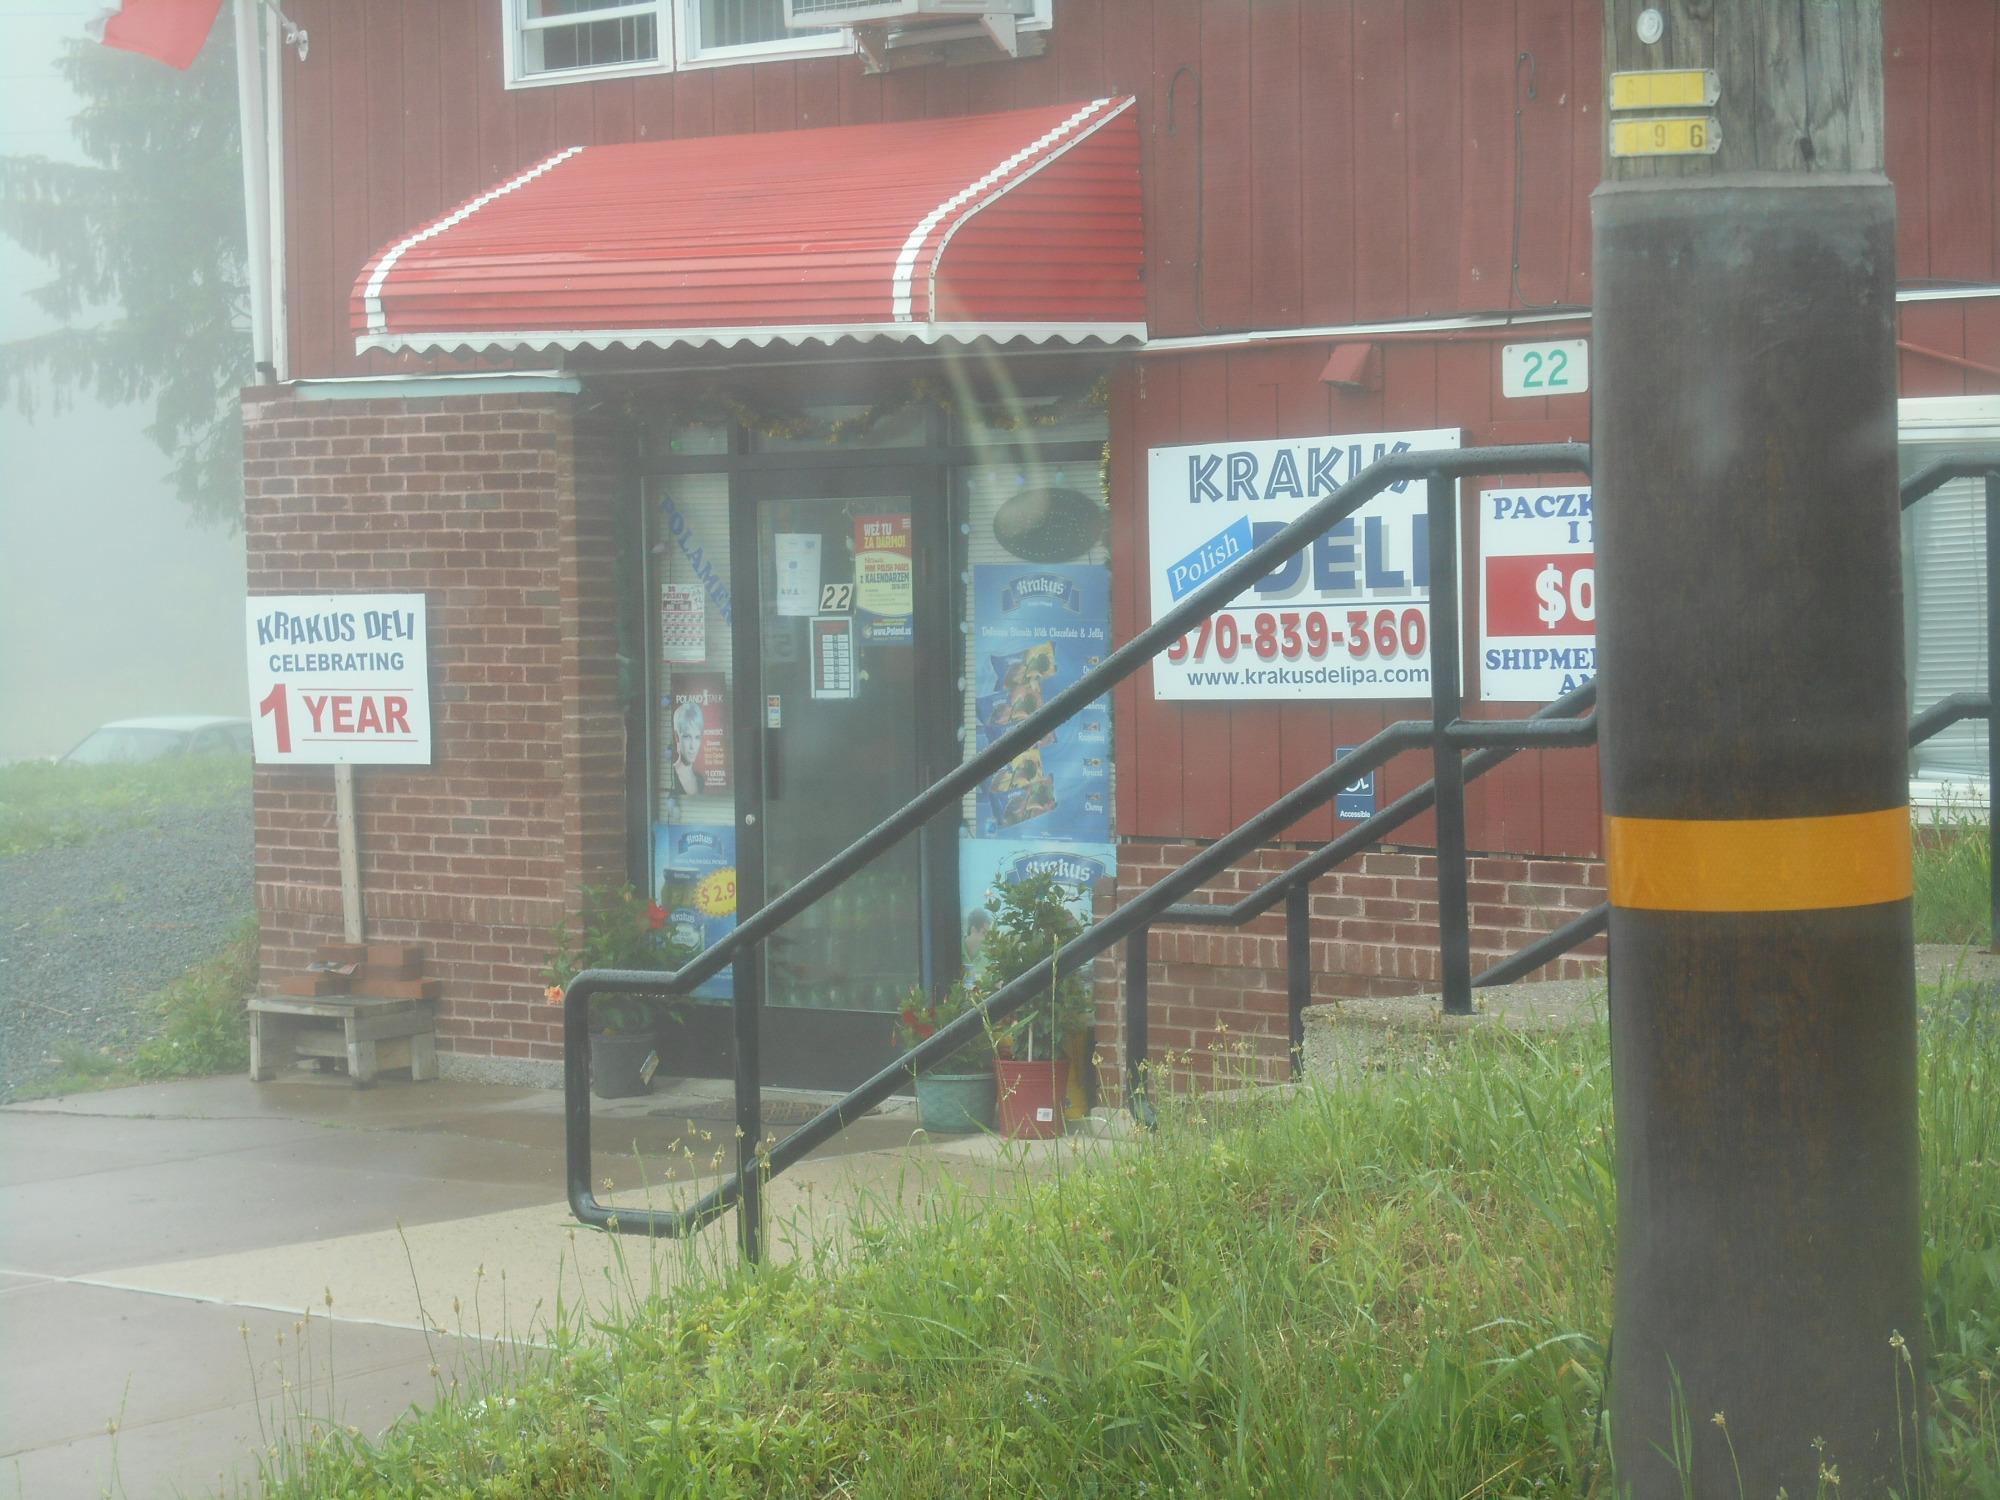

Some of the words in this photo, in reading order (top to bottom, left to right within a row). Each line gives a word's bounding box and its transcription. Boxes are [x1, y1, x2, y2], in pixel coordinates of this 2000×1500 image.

[1522, 349, 1569, 389] 22
[864, 537, 875, 549] ZA
[1171, 532, 1240, 594] Polish
[1252, 513, 1429, 598] DELI
[821, 585, 851, 609] 22
[1016, 577, 1065, 596] Krakus
[257, 610, 356, 646] KRAKUS
[363, 609, 415, 642] DELI
[269, 652, 404, 673] CELEBRATING
[1187, 665, 1429, 687] www.krakusdelipa.com
[260, 683, 292, 754] 1
[302, 695, 412, 734] YEAR
[1340, 810, 1370, 818] Accessible
